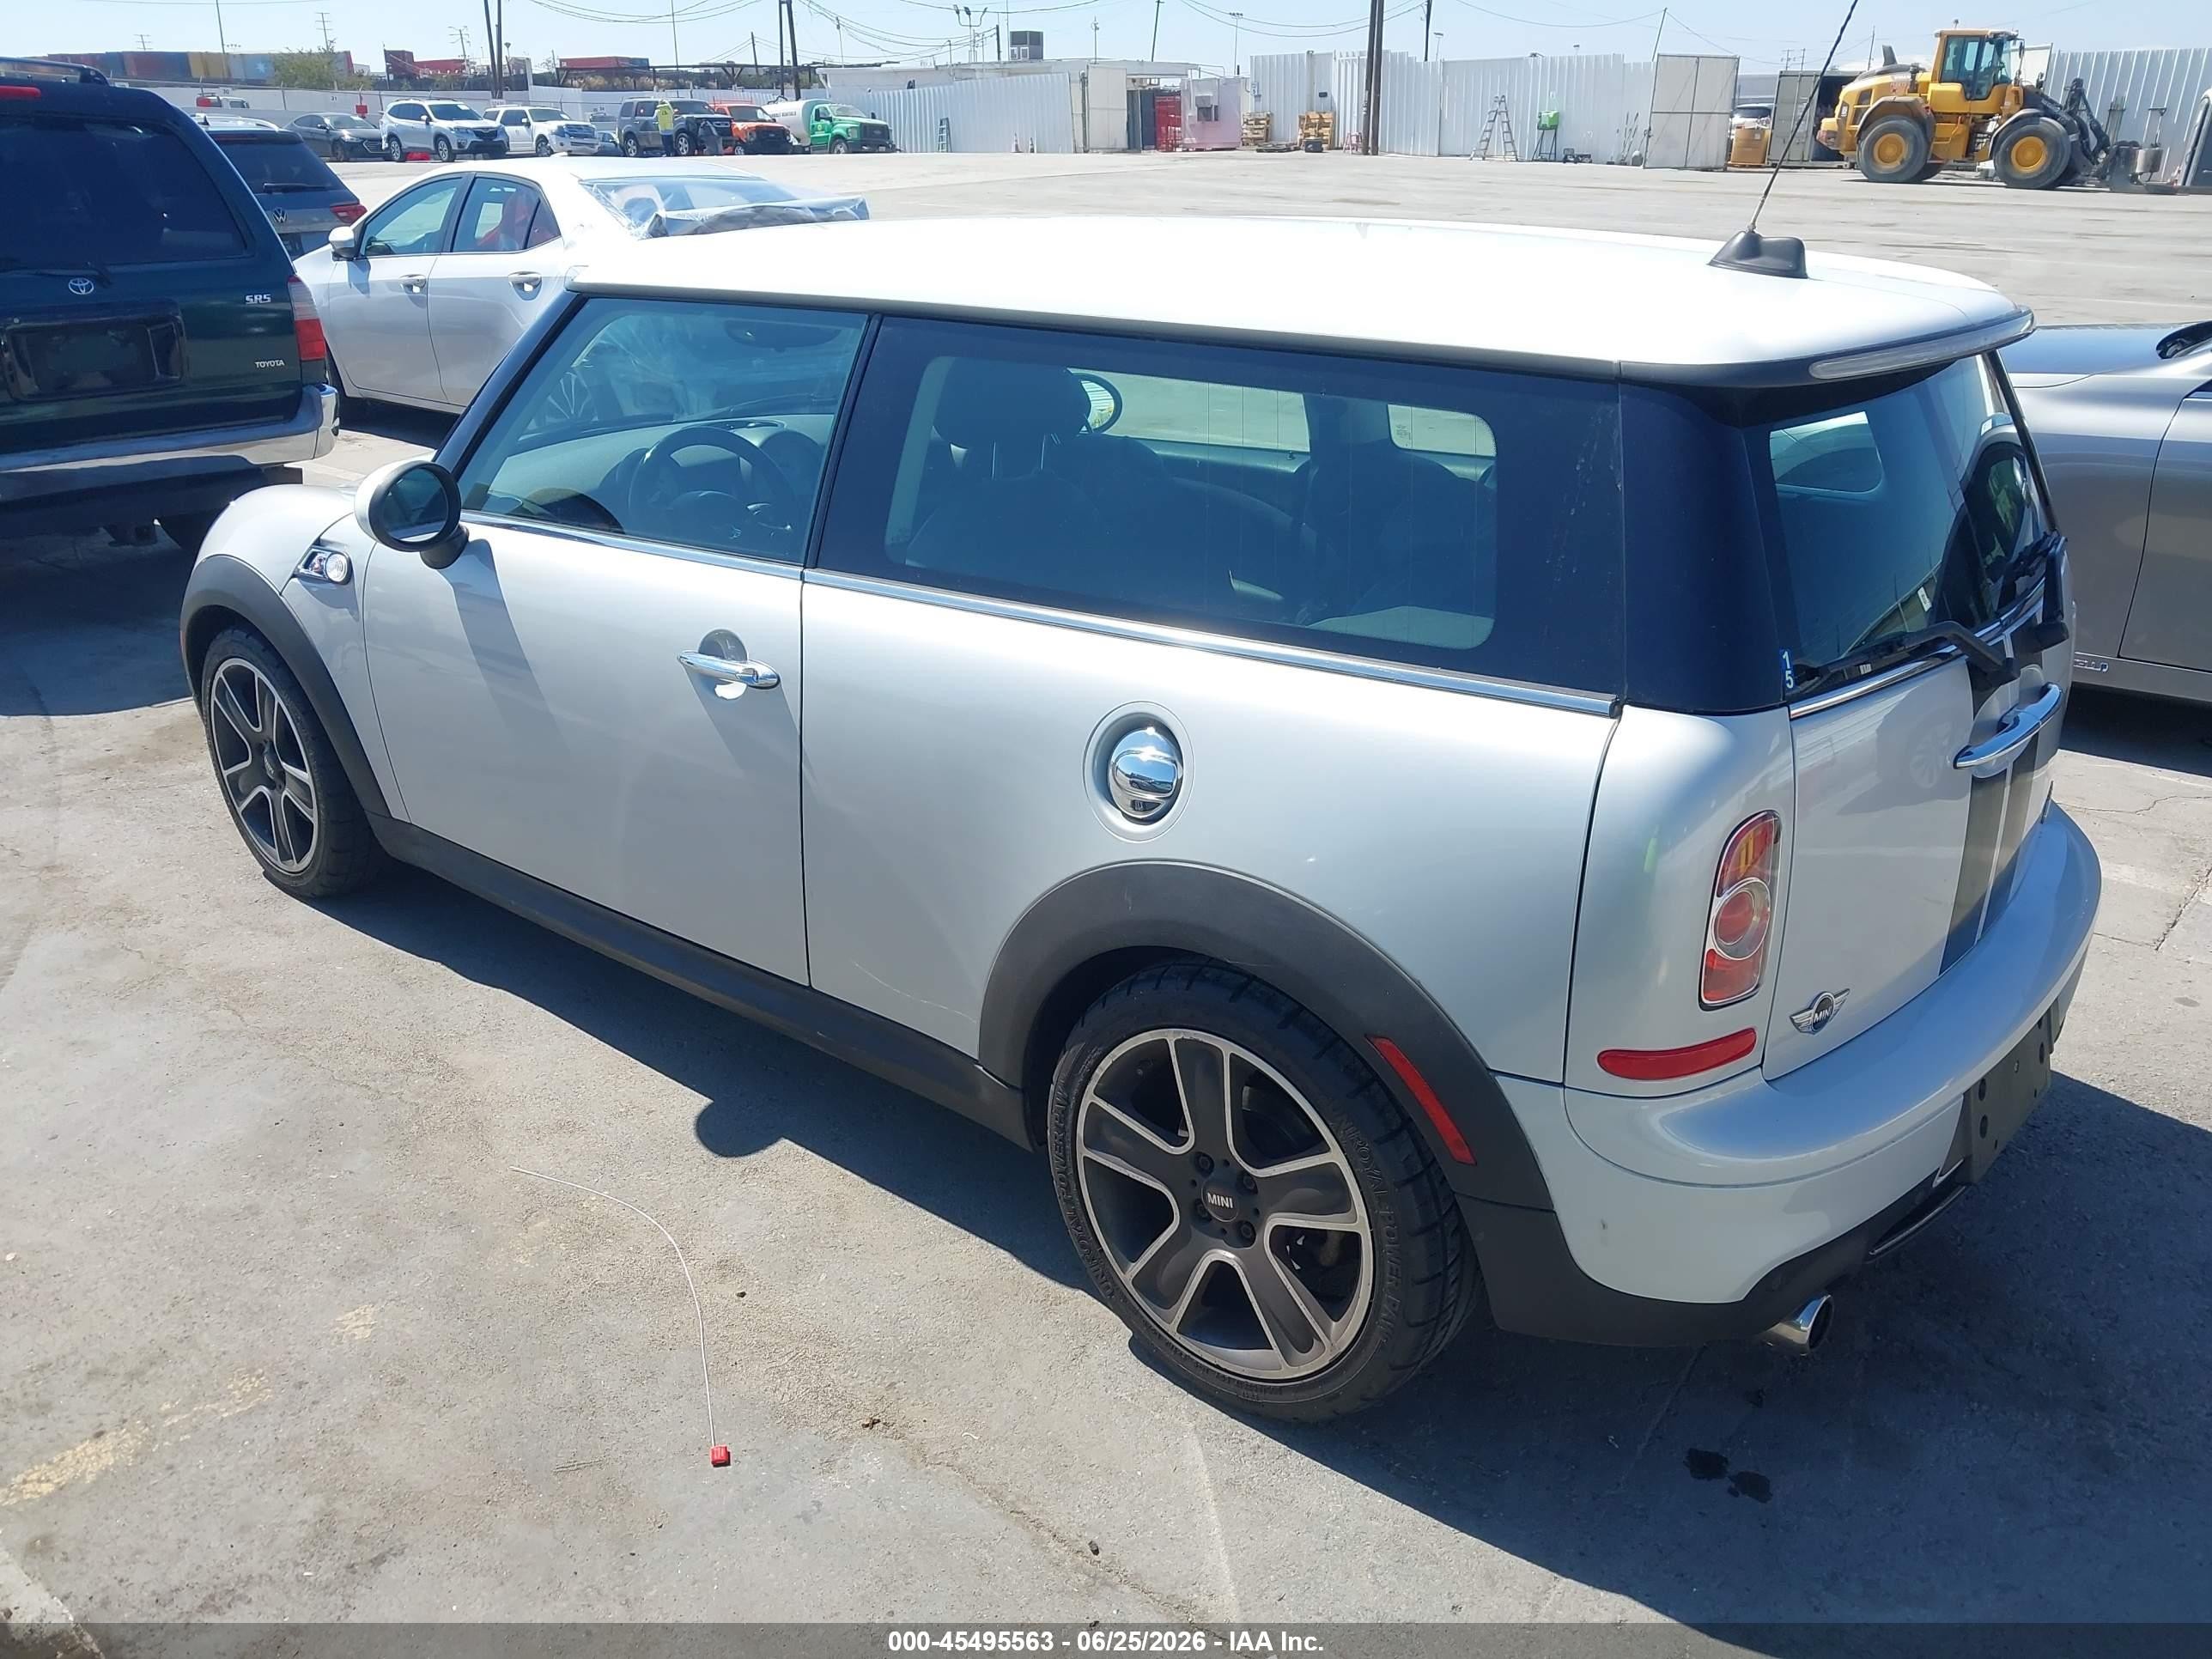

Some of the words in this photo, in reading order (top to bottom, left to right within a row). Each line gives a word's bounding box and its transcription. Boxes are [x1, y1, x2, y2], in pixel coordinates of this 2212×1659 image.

[254, 360, 285, 368] TOYOTA
[1814, 1006, 1832, 1024] MINI
[1207, 1192, 1234, 1209] MINI
